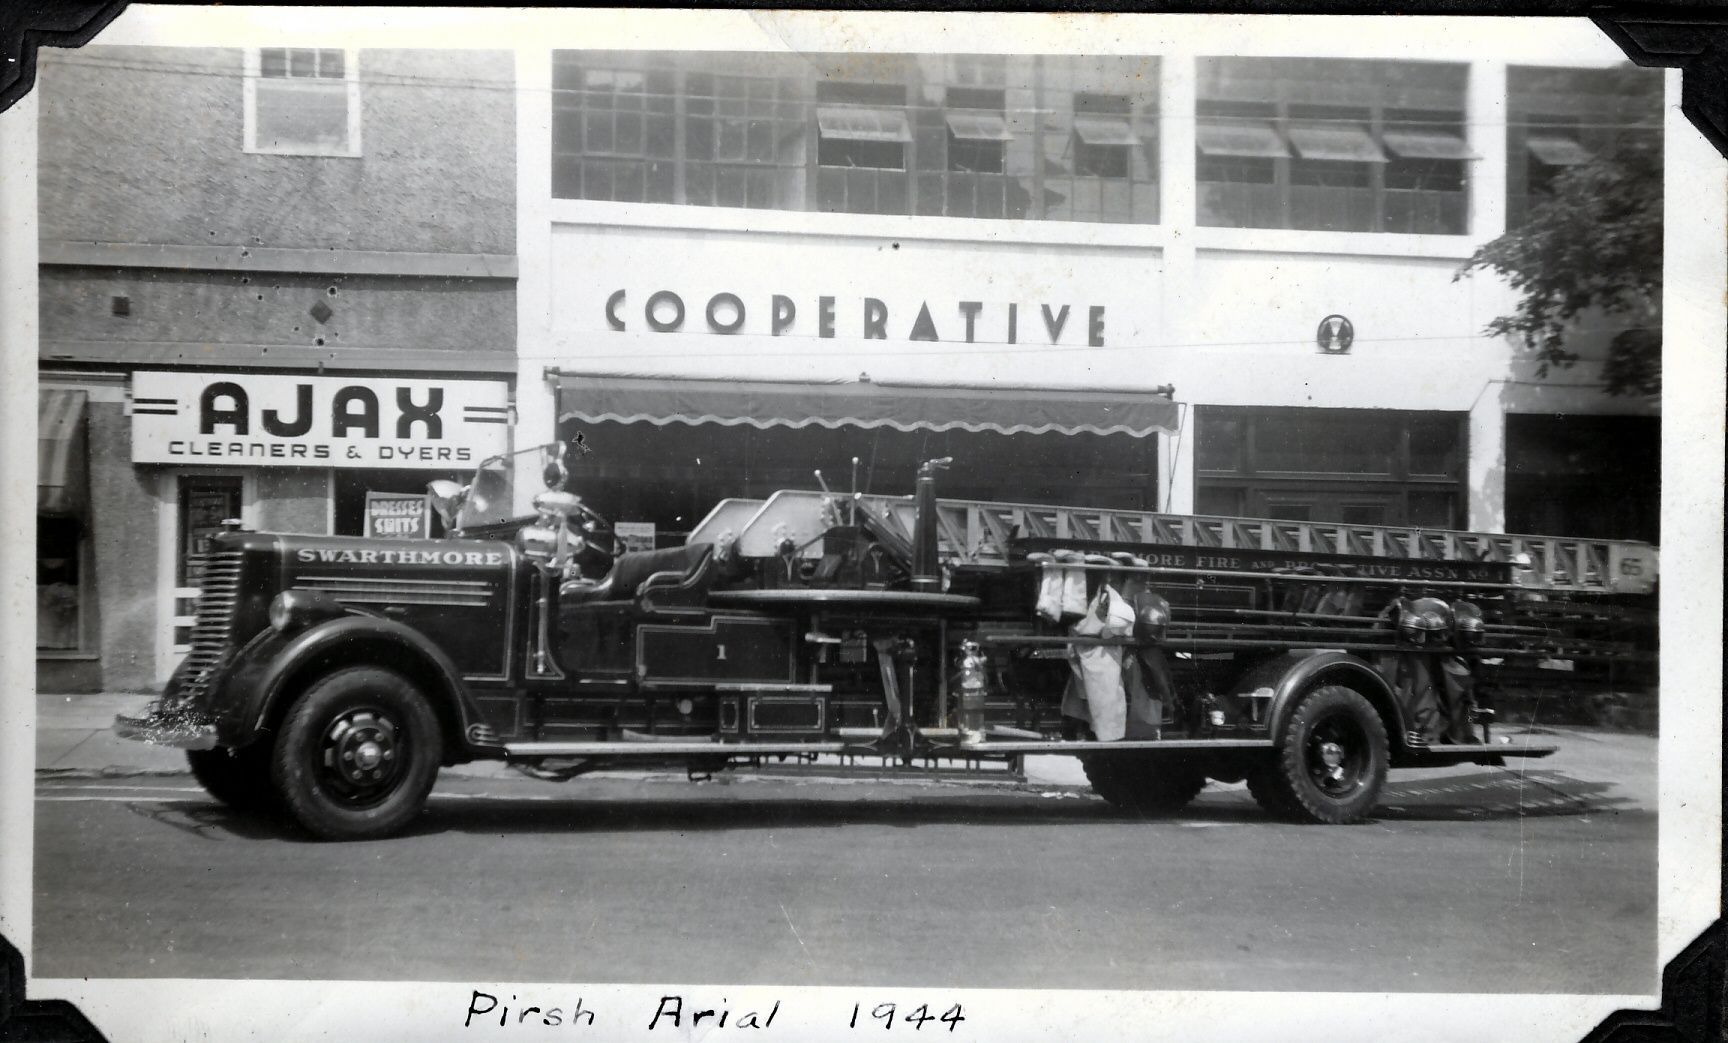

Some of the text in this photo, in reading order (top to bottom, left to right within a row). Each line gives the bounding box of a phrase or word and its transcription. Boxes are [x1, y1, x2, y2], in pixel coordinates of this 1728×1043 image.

[605, 289, 1105, 348] COOPERATIVE
[200, 381, 444, 440] AJAX
[168, 440, 471, 461] CLEANERS & DYERS
[375, 517, 419, 533] SUITS
[297, 548, 503, 566] SWARTHMORE
[1196, 553, 1241, 569] FIRE
[1621, 557, 1643, 576] 65
[717, 644, 727, 660] 1
[464, 990, 967, 1032] Pirsh Arial 1944
